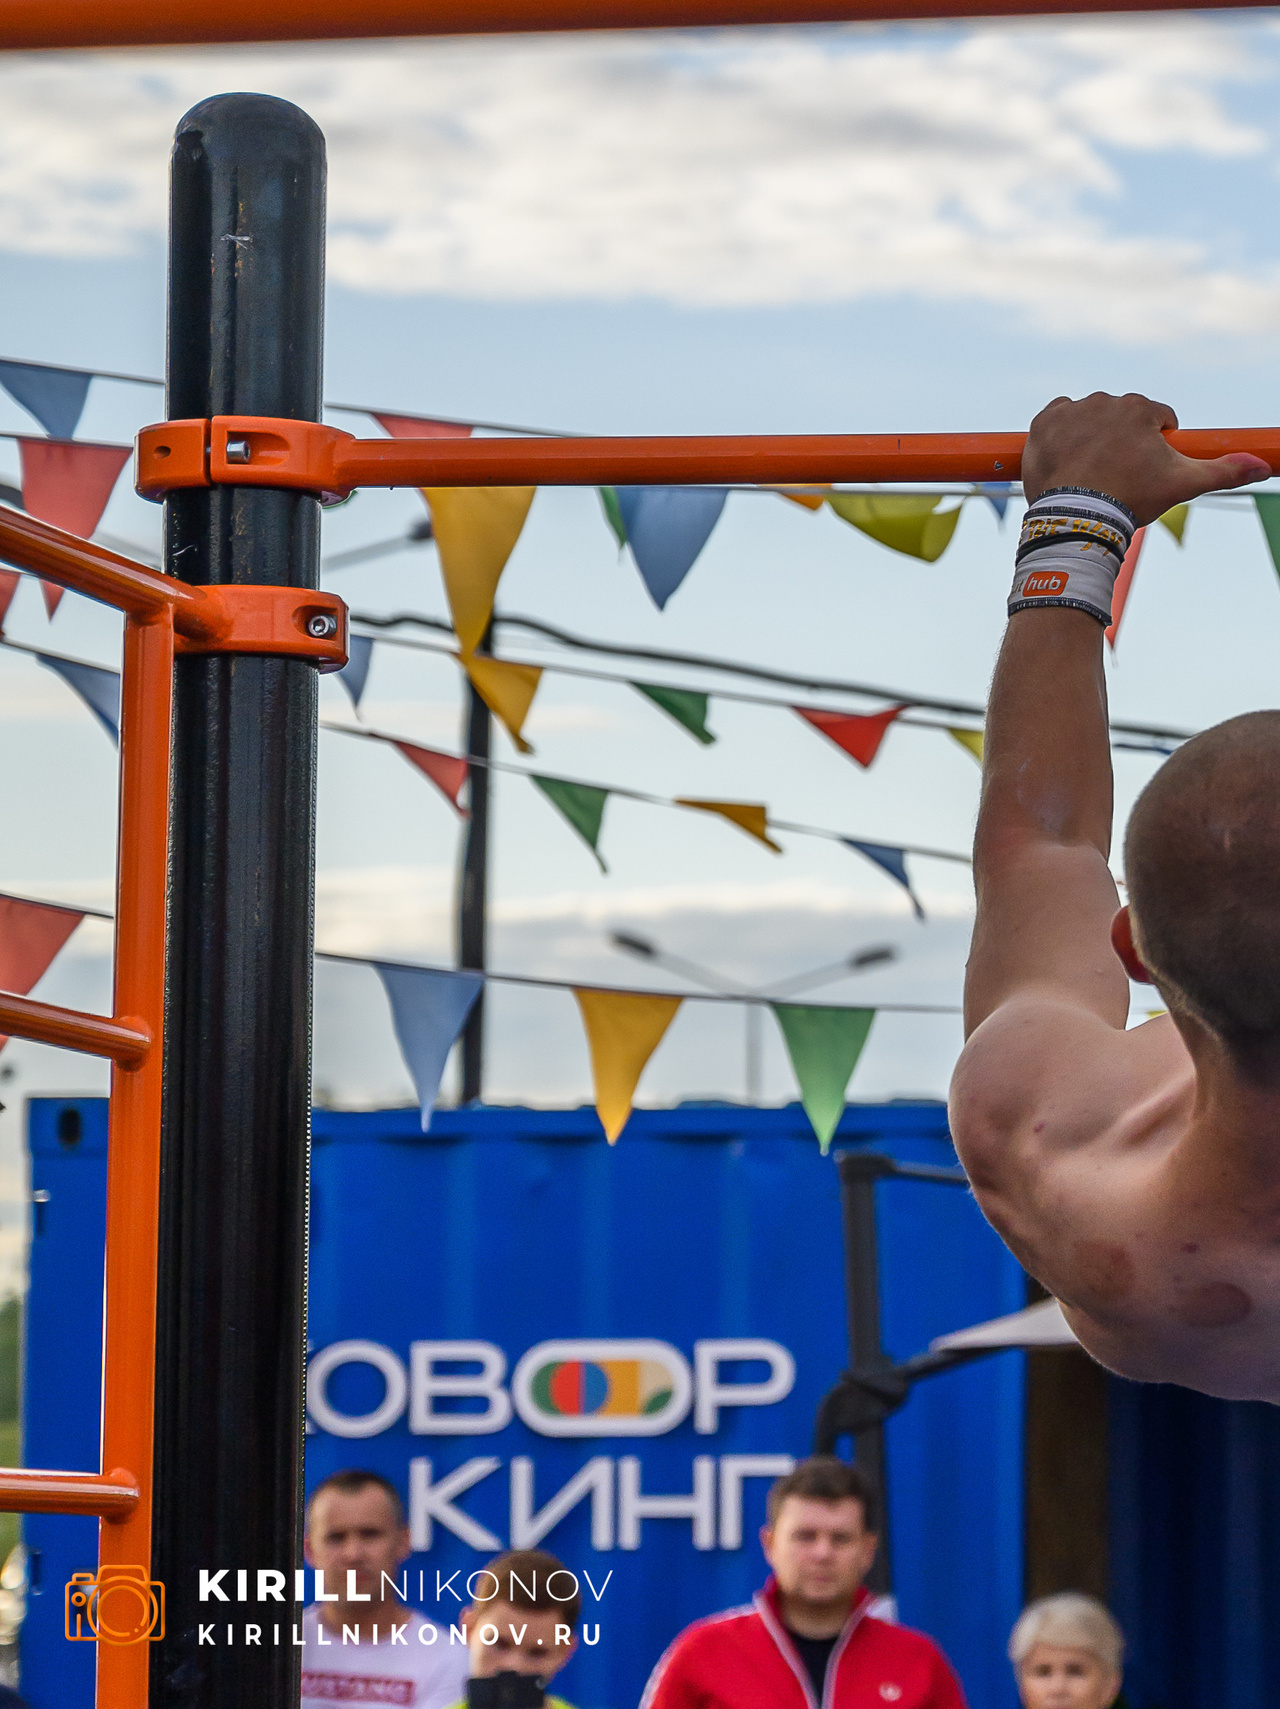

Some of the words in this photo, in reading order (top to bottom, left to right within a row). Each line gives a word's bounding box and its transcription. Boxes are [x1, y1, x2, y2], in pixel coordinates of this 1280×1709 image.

[1027, 575, 1061, 591] hub
[304, 1339, 796, 1437] ОВОР
[409, 1455, 796, 1551] КИНГ
